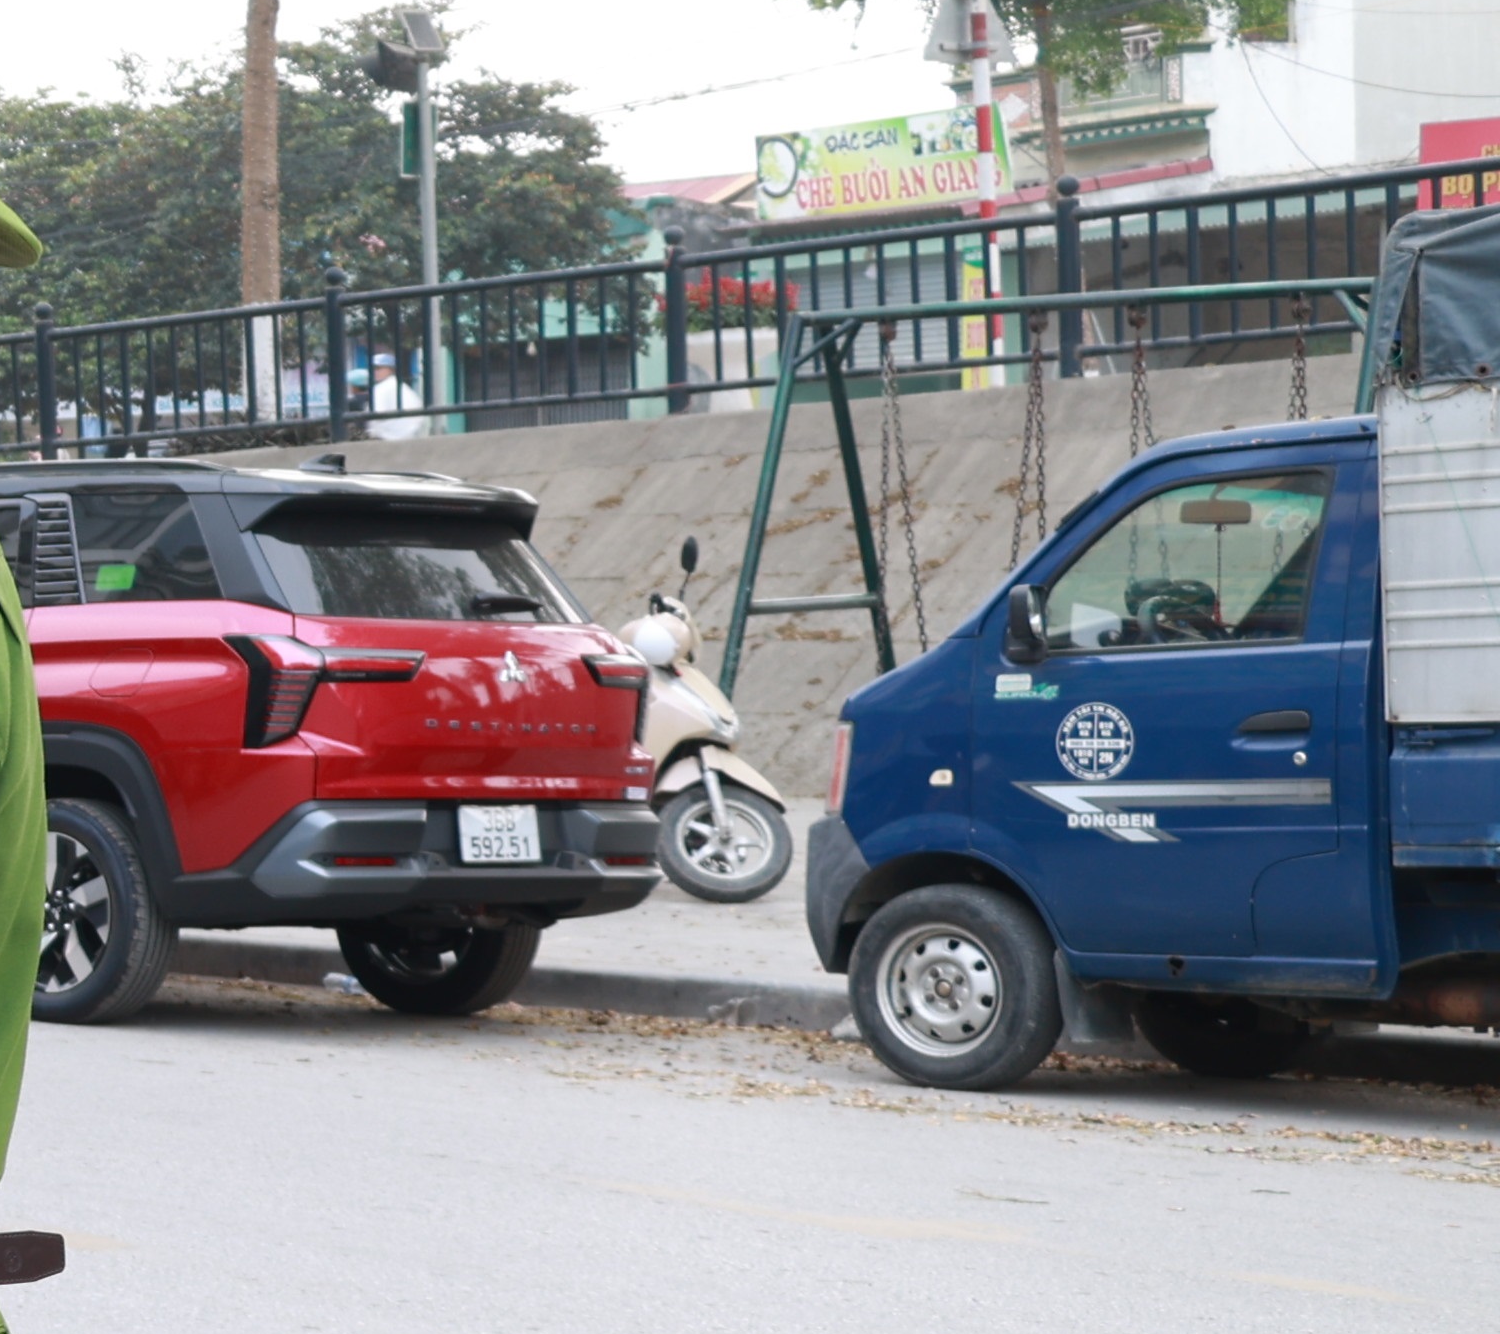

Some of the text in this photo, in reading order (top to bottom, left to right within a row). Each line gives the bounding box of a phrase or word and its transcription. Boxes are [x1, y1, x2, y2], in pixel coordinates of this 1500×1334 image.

[796, 169, 835, 210] CHÈ
[841, 158, 890, 205] BƯỞI
[898, 166, 928, 198] AN
[1067, 813, 1156, 828] DONGBEN
[471, 836, 530, 858] 592.51
